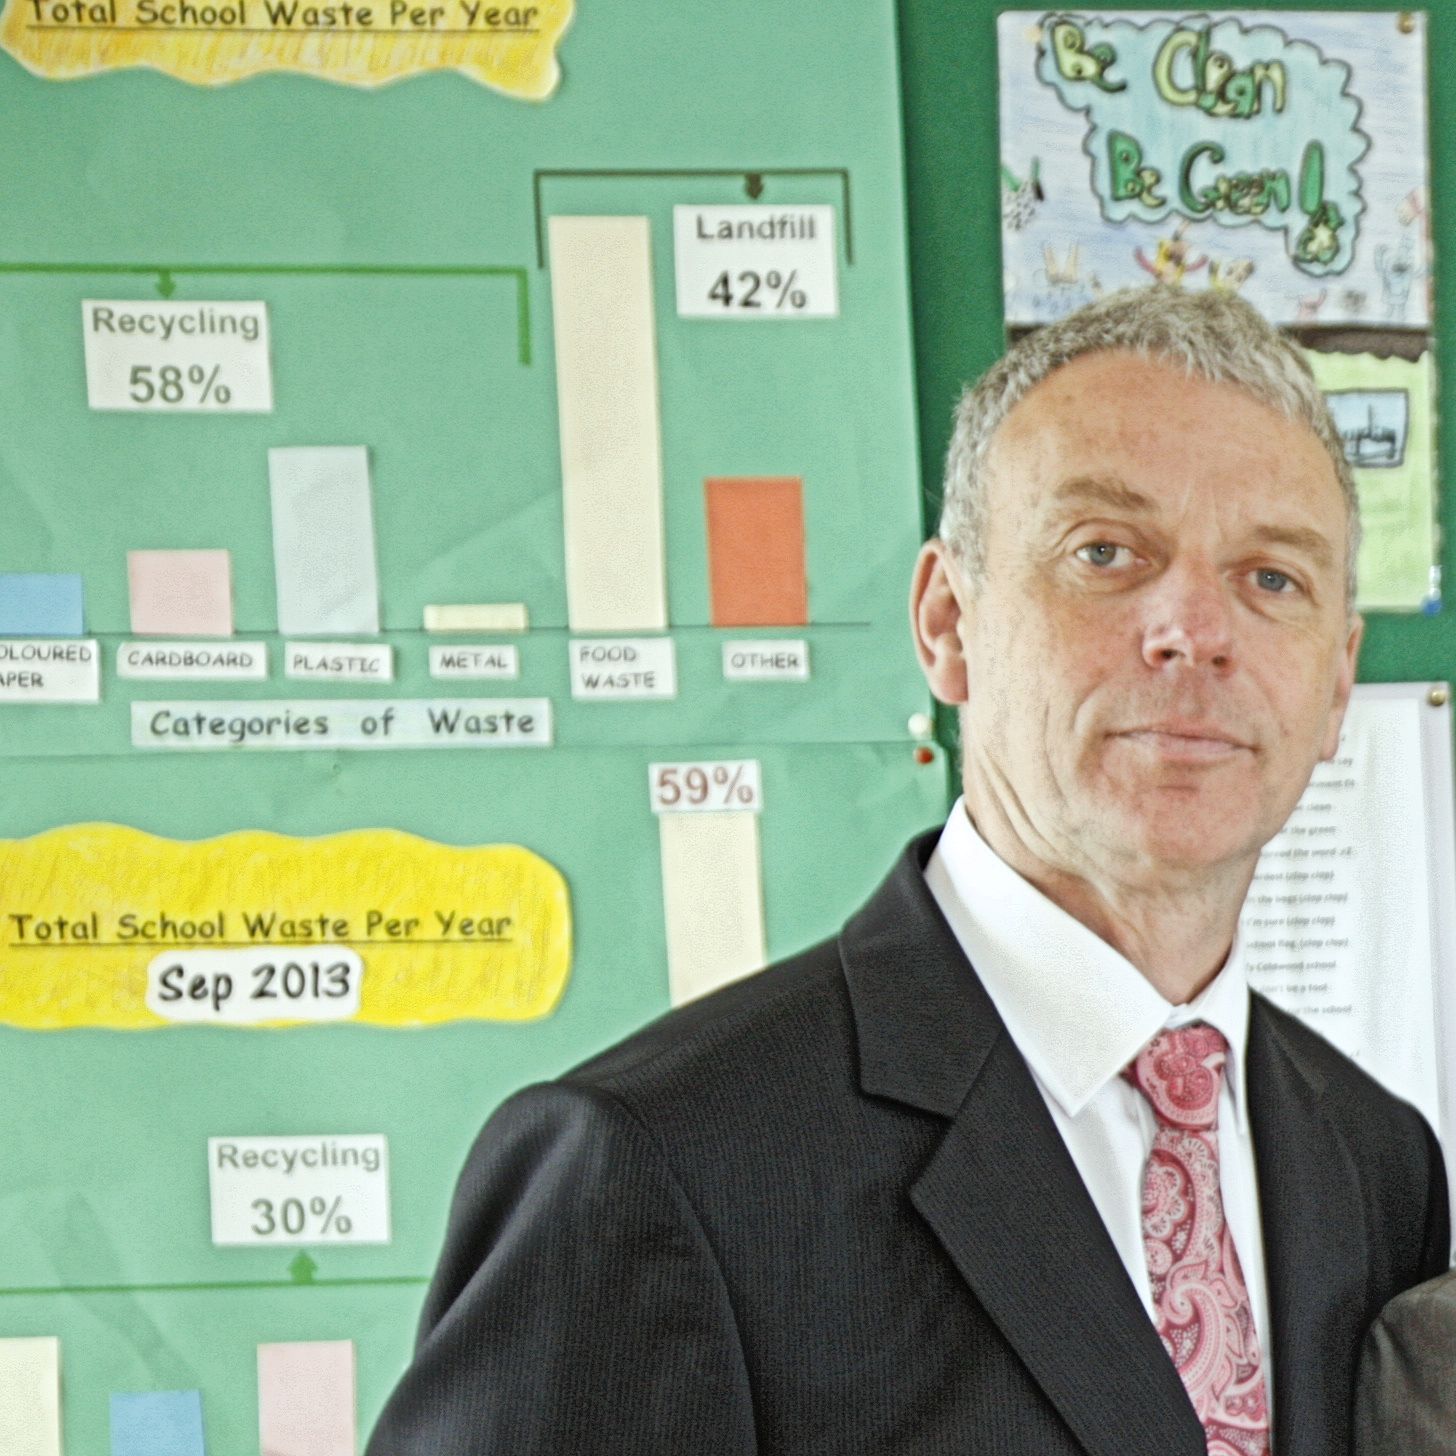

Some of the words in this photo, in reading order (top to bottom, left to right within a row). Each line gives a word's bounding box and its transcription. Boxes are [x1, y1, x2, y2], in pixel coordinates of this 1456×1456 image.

[32, 0, 117, 23] Total
[135, 0, 247, 25] School
[264, 0, 374, 26] Waste
[388, 0, 445, 25] Per
[465, 0, 538, 26] Year
[1050, 20, 1128, 93] Be
[1152, 16, 1287, 119] Clean
[1106, 129, 1166, 207] Be
[695, 212, 818, 242] Landfill
[708, 268, 807, 311] 42%
[91, 305, 260, 342] Recycling
[128, 364, 233, 406] 58%
[127, 649, 254, 669] CARDBOARD
[292, 653, 382, 674] PLASTIC
[439, 651, 509, 670] METAL
[579, 644, 639, 663] FOOD
[730, 652, 802, 669] OTHER
[582, 670, 656, 690] WASTE
[149, 708, 330, 744] Categories
[360, 708, 396, 736] of
[427, 708, 537, 735] Waste
[655, 765, 755, 806] 59%
[7, 912, 99, 941] Total
[117, 911, 227, 941] School
[241, 911, 350, 940] Waste
[365, 910, 420, 938] Per
[431, 910, 514, 939] Year
[158, 964, 234, 1011] Sep
[251, 961, 353, 1001] 2013
[217, 1141, 382, 1174] Recycling
[250, 1195, 353, 1236] 30%
